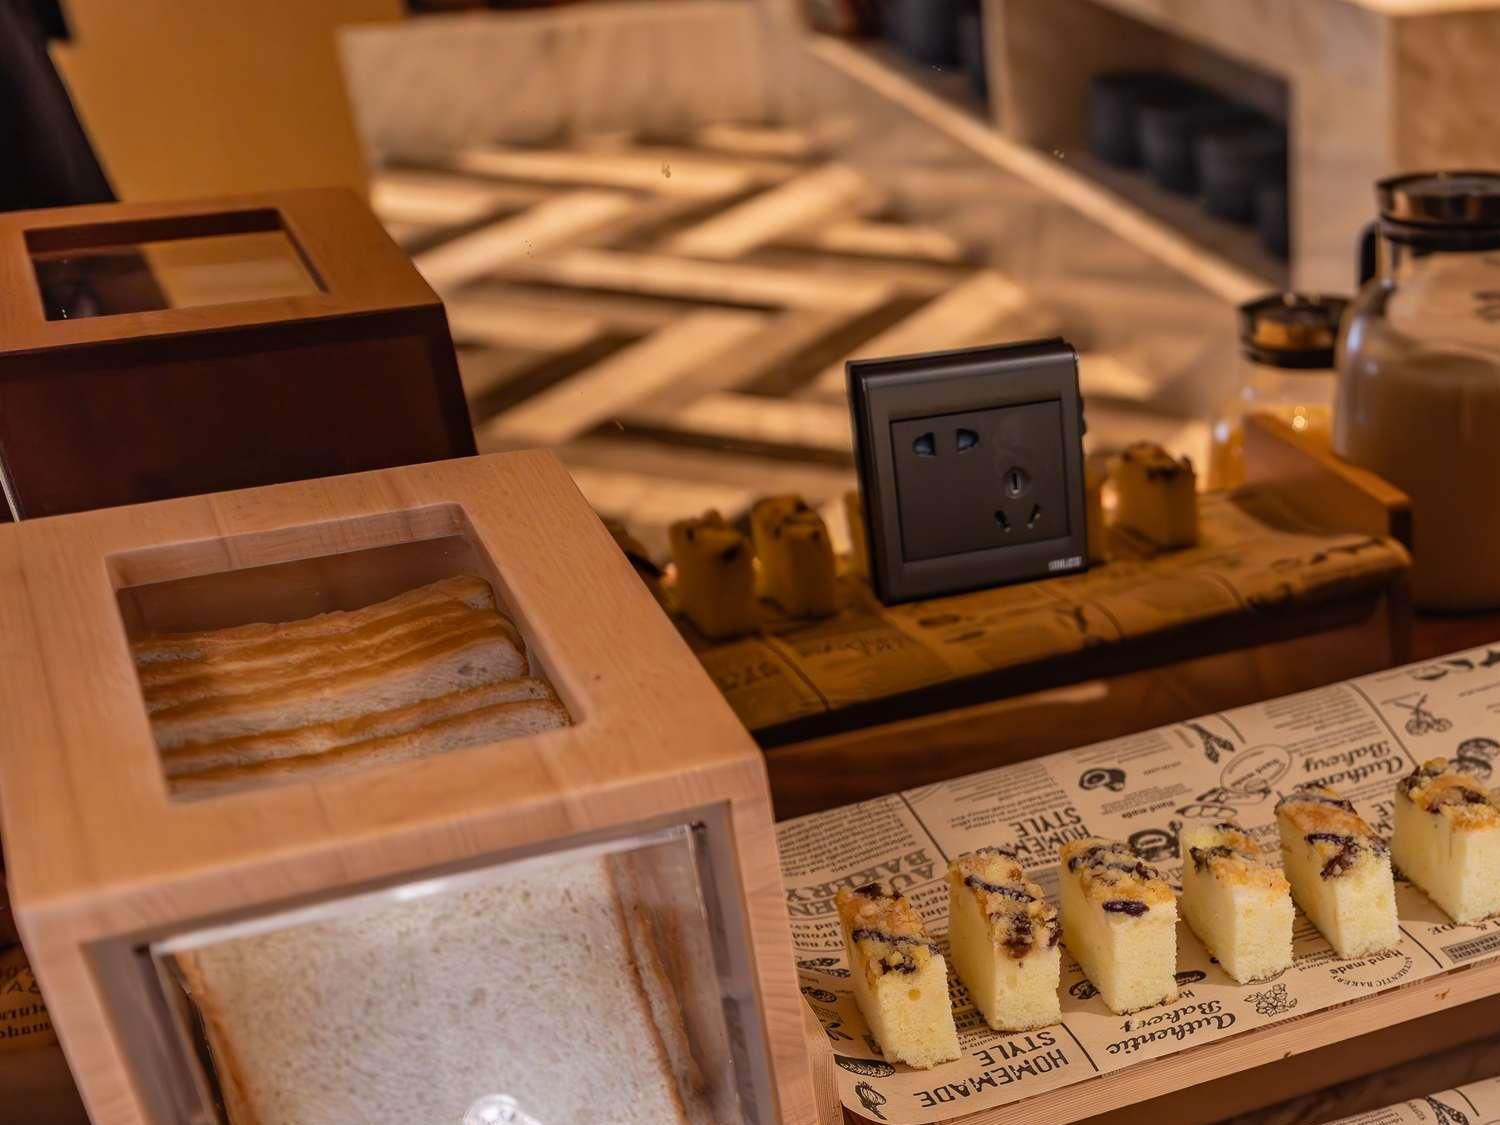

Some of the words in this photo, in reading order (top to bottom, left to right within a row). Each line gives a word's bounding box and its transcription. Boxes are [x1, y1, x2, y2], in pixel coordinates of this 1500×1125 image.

[1302, 741, 1390, 772] Bakery
[1009, 807, 1082, 838] STYLE
[972, 1031, 1056, 1067] STYLE
[1105, 1013, 1236, 1054] Authentic
[913, 1048, 1069, 1107] HOMEMADE
